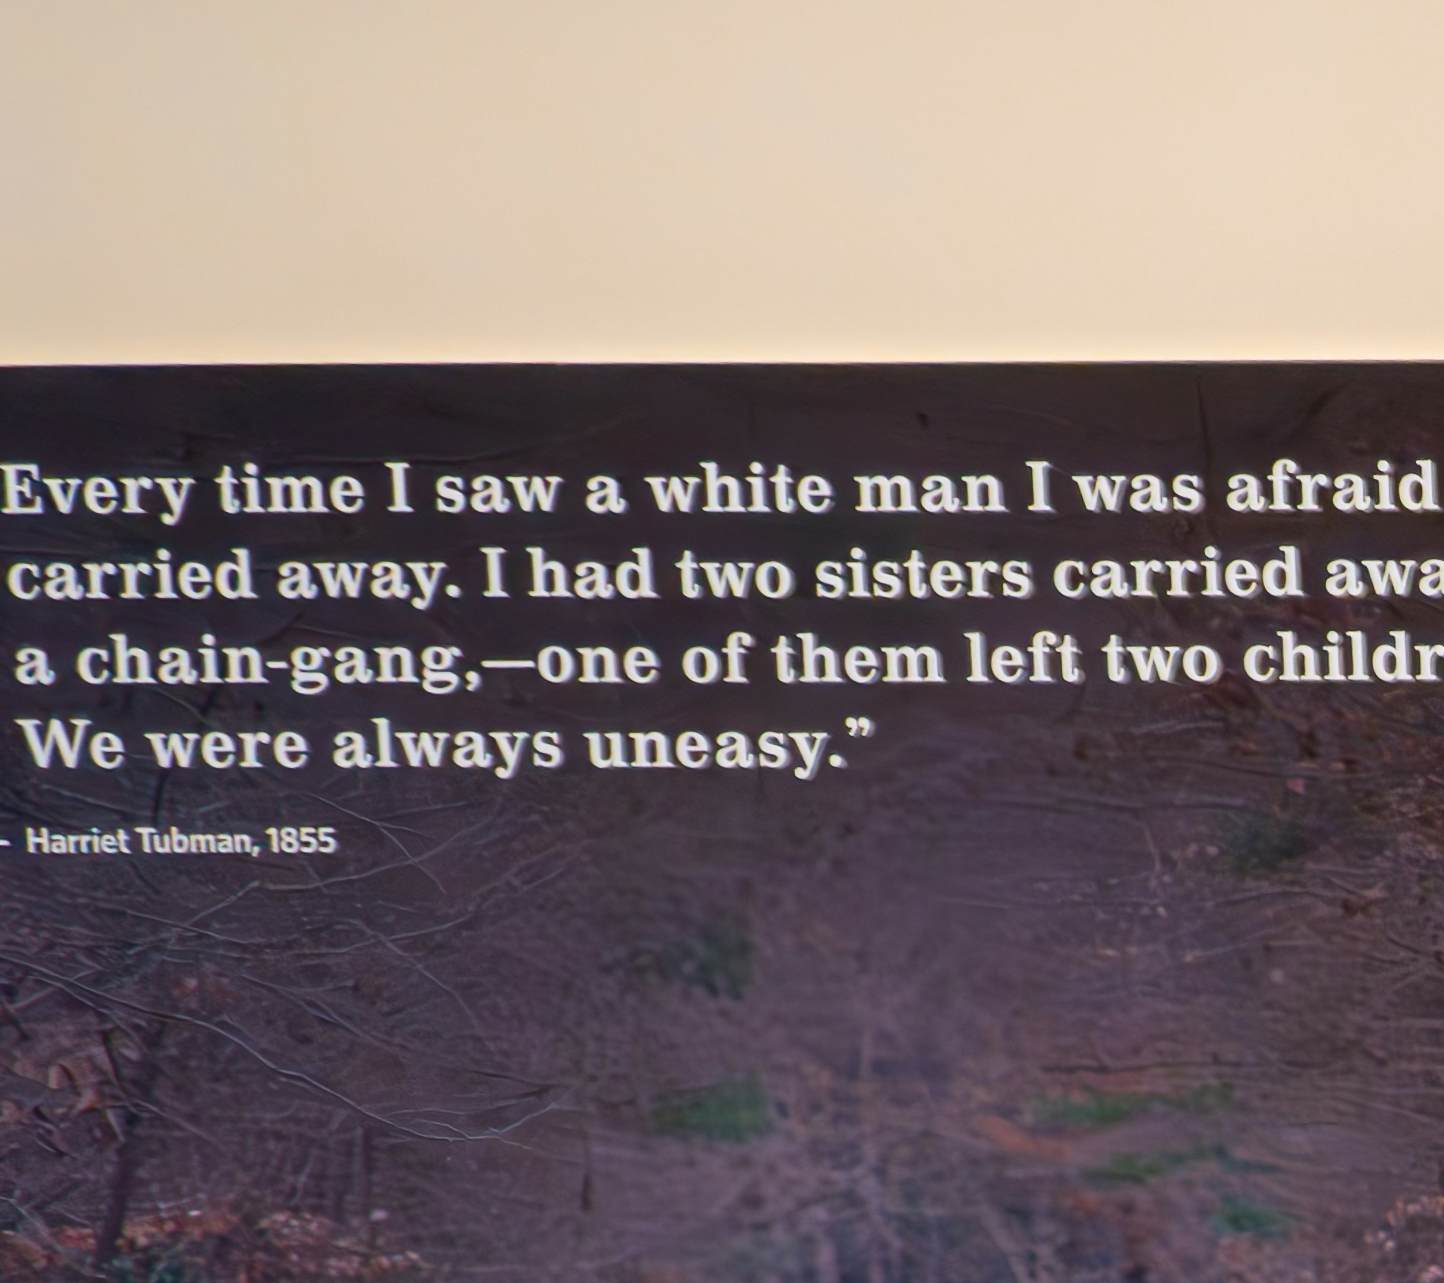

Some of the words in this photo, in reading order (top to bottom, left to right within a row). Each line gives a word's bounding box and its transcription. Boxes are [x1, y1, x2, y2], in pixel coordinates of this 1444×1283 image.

[0, 463, 196, 526] Every
[214, 462, 365, 514] time
[384, 462, 414, 513] I
[436, 474, 564, 514] saw
[586, 475, 627, 514] a
[643, 461, 833, 514] white
[853, 474, 1009, 514] man
[1025, 460, 1054, 513] I
[1071, 473, 1204, 513] was
[1226, 458, 1441, 513] afraid
[8, 547, 258, 601] carried
[278, 561, 461, 610] away.
[480, 546, 509, 598] I
[525, 546, 659, 600] had
[674, 549, 793, 599] two
[815, 546, 1034, 599] sisters
[1053, 545, 1305, 599] carried
[15, 647, 56, 686] a
[77, 633, 659, 695] chain-gang,—one
[682, 631, 754, 684] of
[770, 632, 947, 684] them
[963, 630, 1082, 684] left
[1100, 634, 1222, 684] two
[14, 718, 125, 770] We
[143, 731, 309, 769] were
[333, 717, 564, 780] always
[582, 716, 874, 780] uneasy.”
[26, 827, 132, 854] Harriet
[133, 826, 261, 858] Tubman,
[265, 826, 338, 854] 1855
